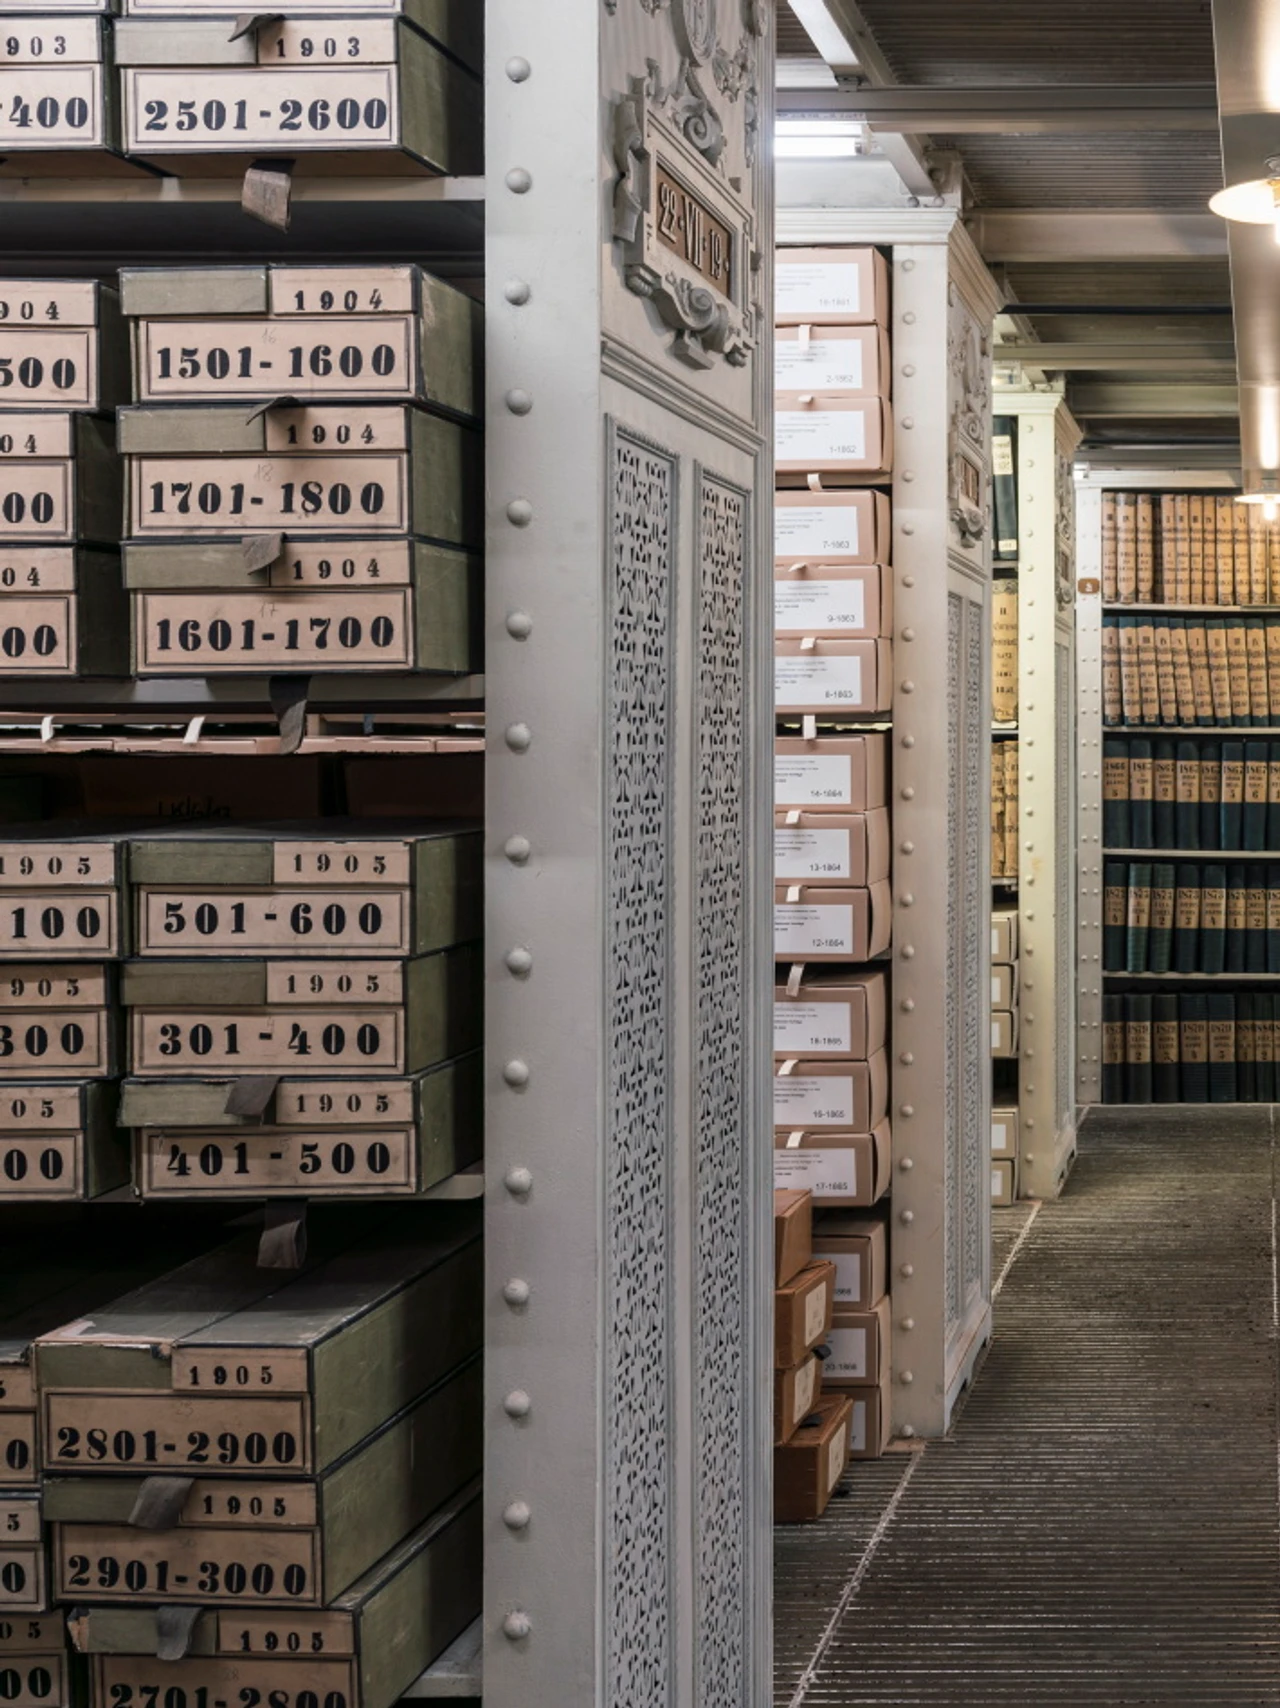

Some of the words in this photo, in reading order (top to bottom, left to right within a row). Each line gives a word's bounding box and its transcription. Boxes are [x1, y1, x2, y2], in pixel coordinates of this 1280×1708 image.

[272, 36, 359, 58] 1903
[290, 289, 388, 315] 1904
[282, 422, 373, 448] 1904
[290, 553, 379, 584] 1904
[295, 854, 385, 874] 1905
[288, 975, 379, 993] 1905
[298, 1095, 388, 1112] 1905
[190, 1366, 272, 1385] 1905
[203, 1495, 285, 1516] 1905
[236, 1631, 328, 1655] 1905
